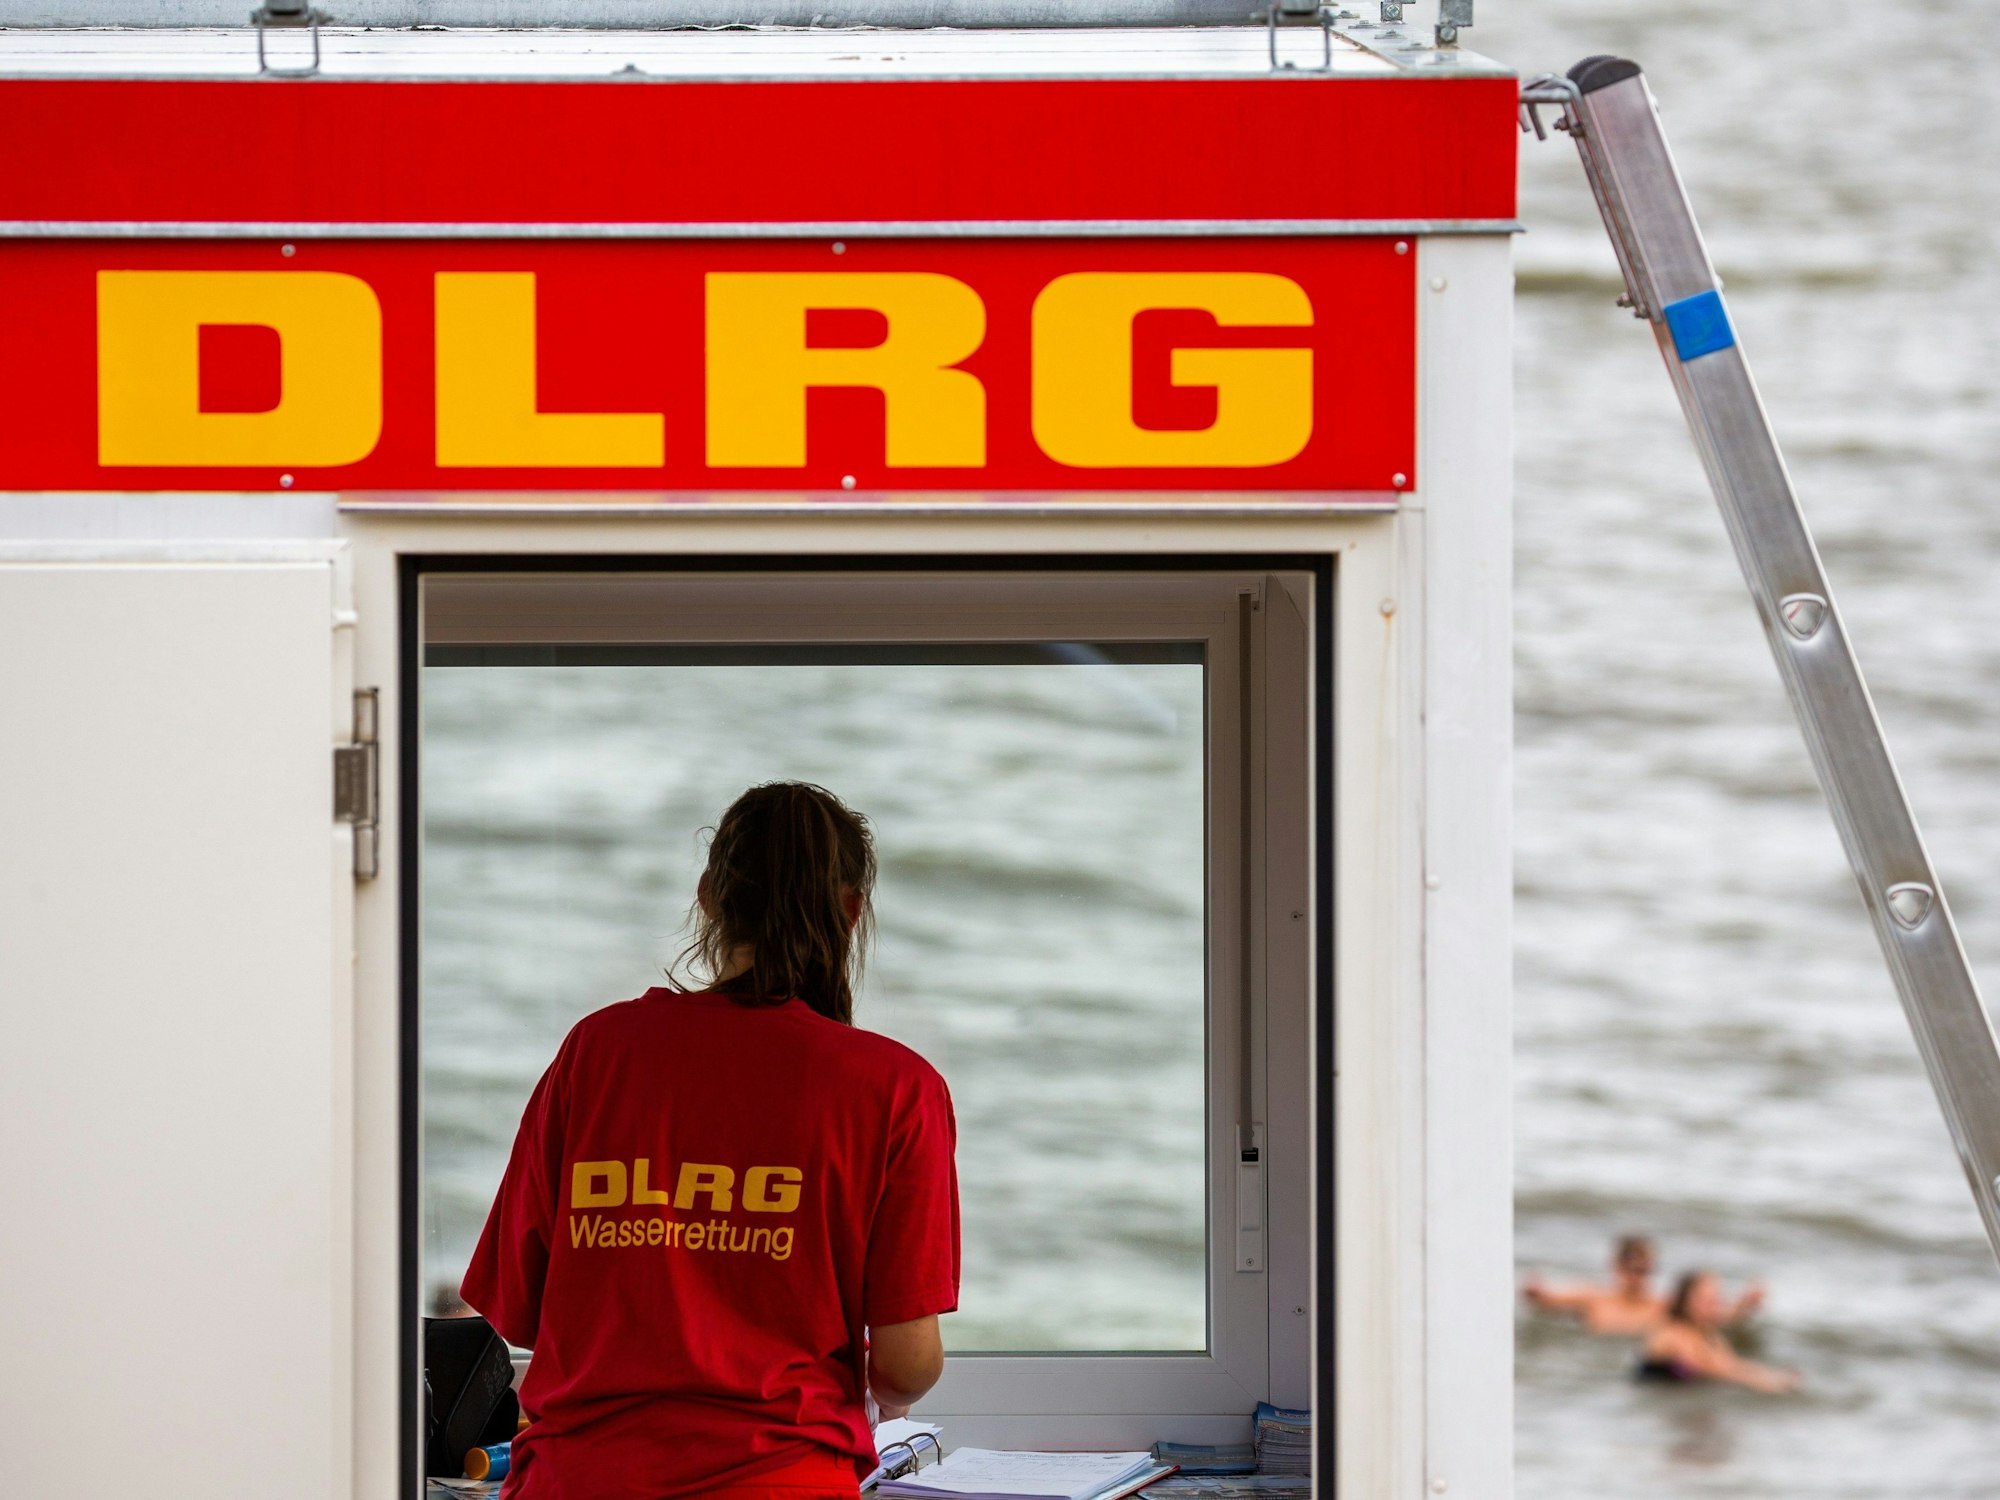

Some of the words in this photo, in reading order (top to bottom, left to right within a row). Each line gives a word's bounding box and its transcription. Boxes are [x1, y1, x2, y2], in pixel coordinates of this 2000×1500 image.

[96, 270, 1314, 468] DLRG
[570, 1158, 803, 1213] DLRG
[569, 1214, 795, 1261] Wasserrettung
